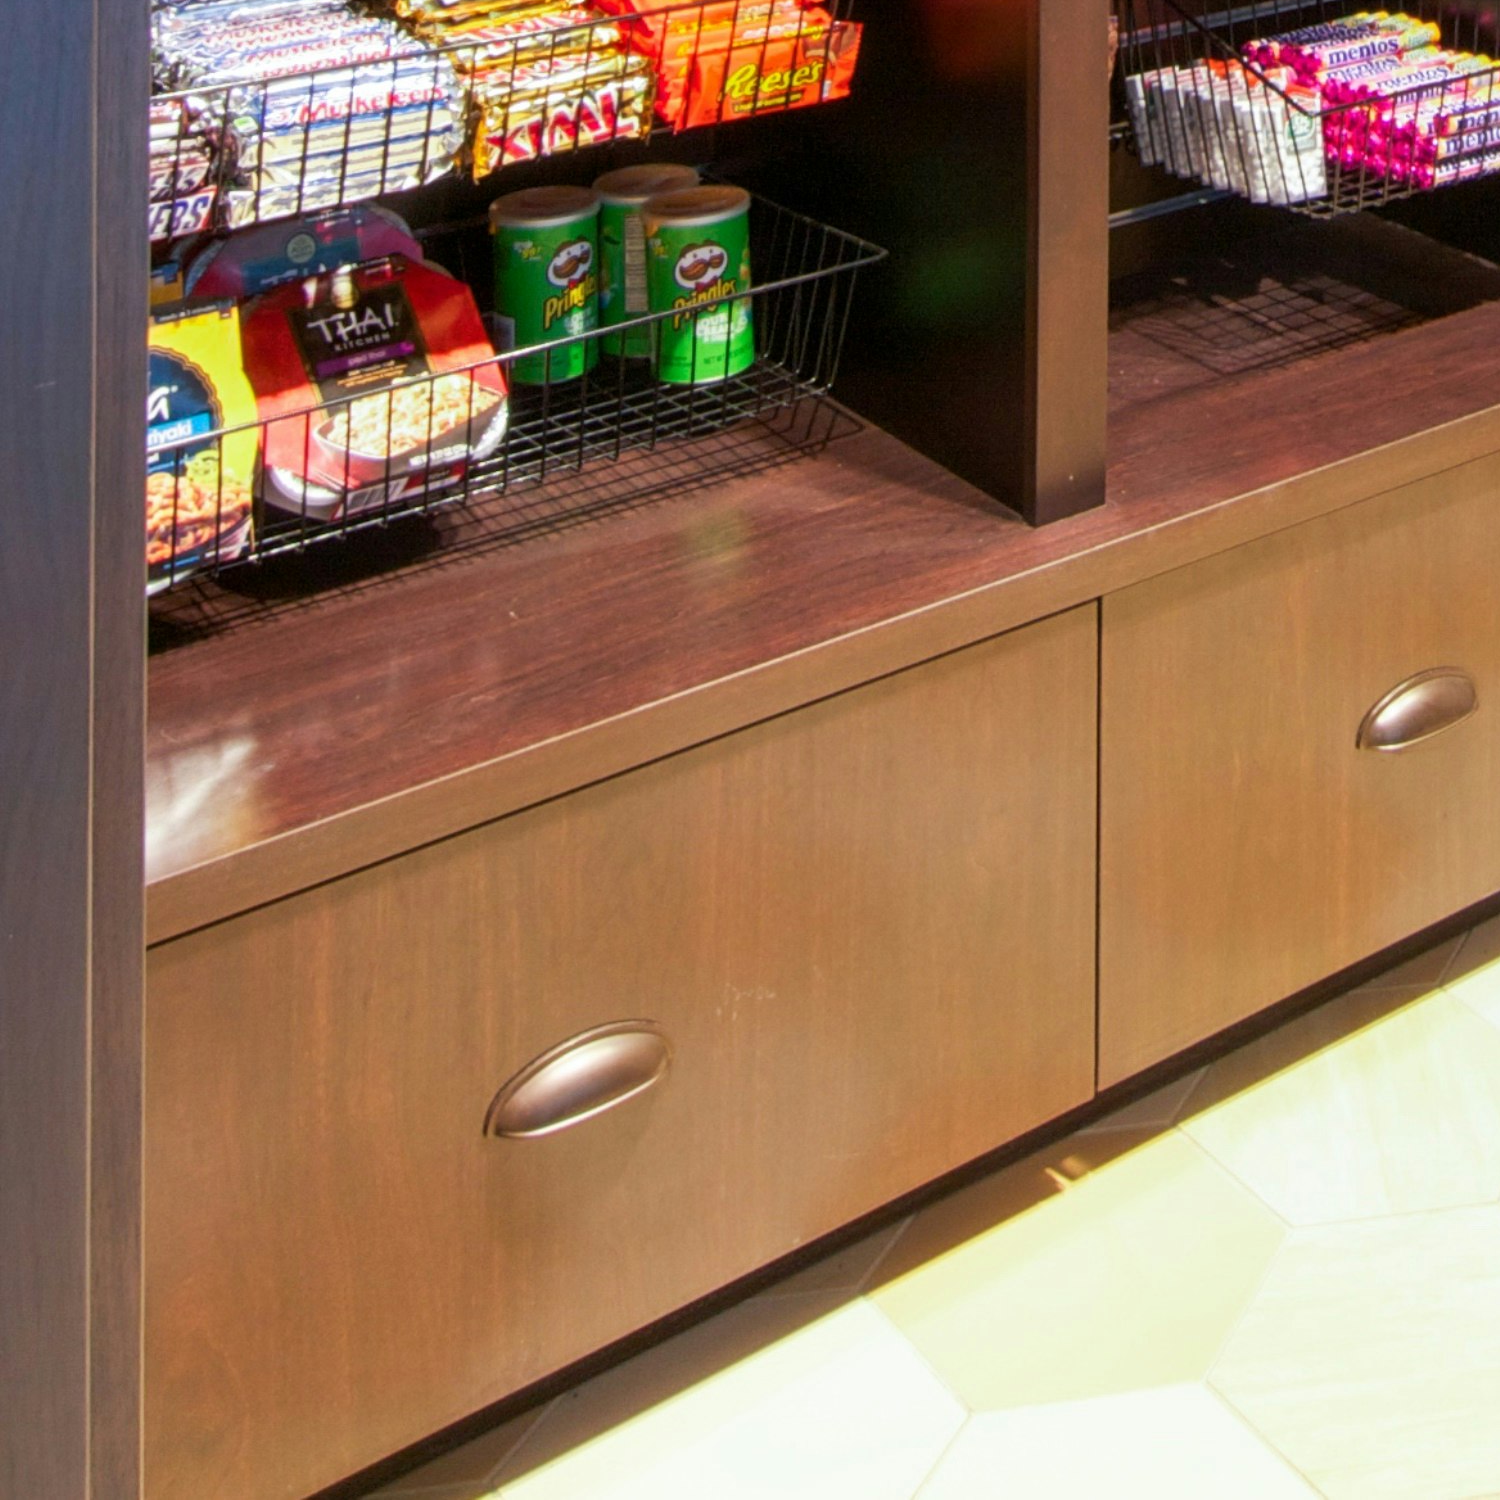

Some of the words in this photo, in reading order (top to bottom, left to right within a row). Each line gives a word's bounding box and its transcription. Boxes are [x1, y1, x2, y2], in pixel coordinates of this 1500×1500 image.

[1328, 37, 1400, 66] mentos
[722, 61, 824, 100] Reese's
[307, 303, 396, 343] THAI
[334, 333, 391, 352] KITCHEN
